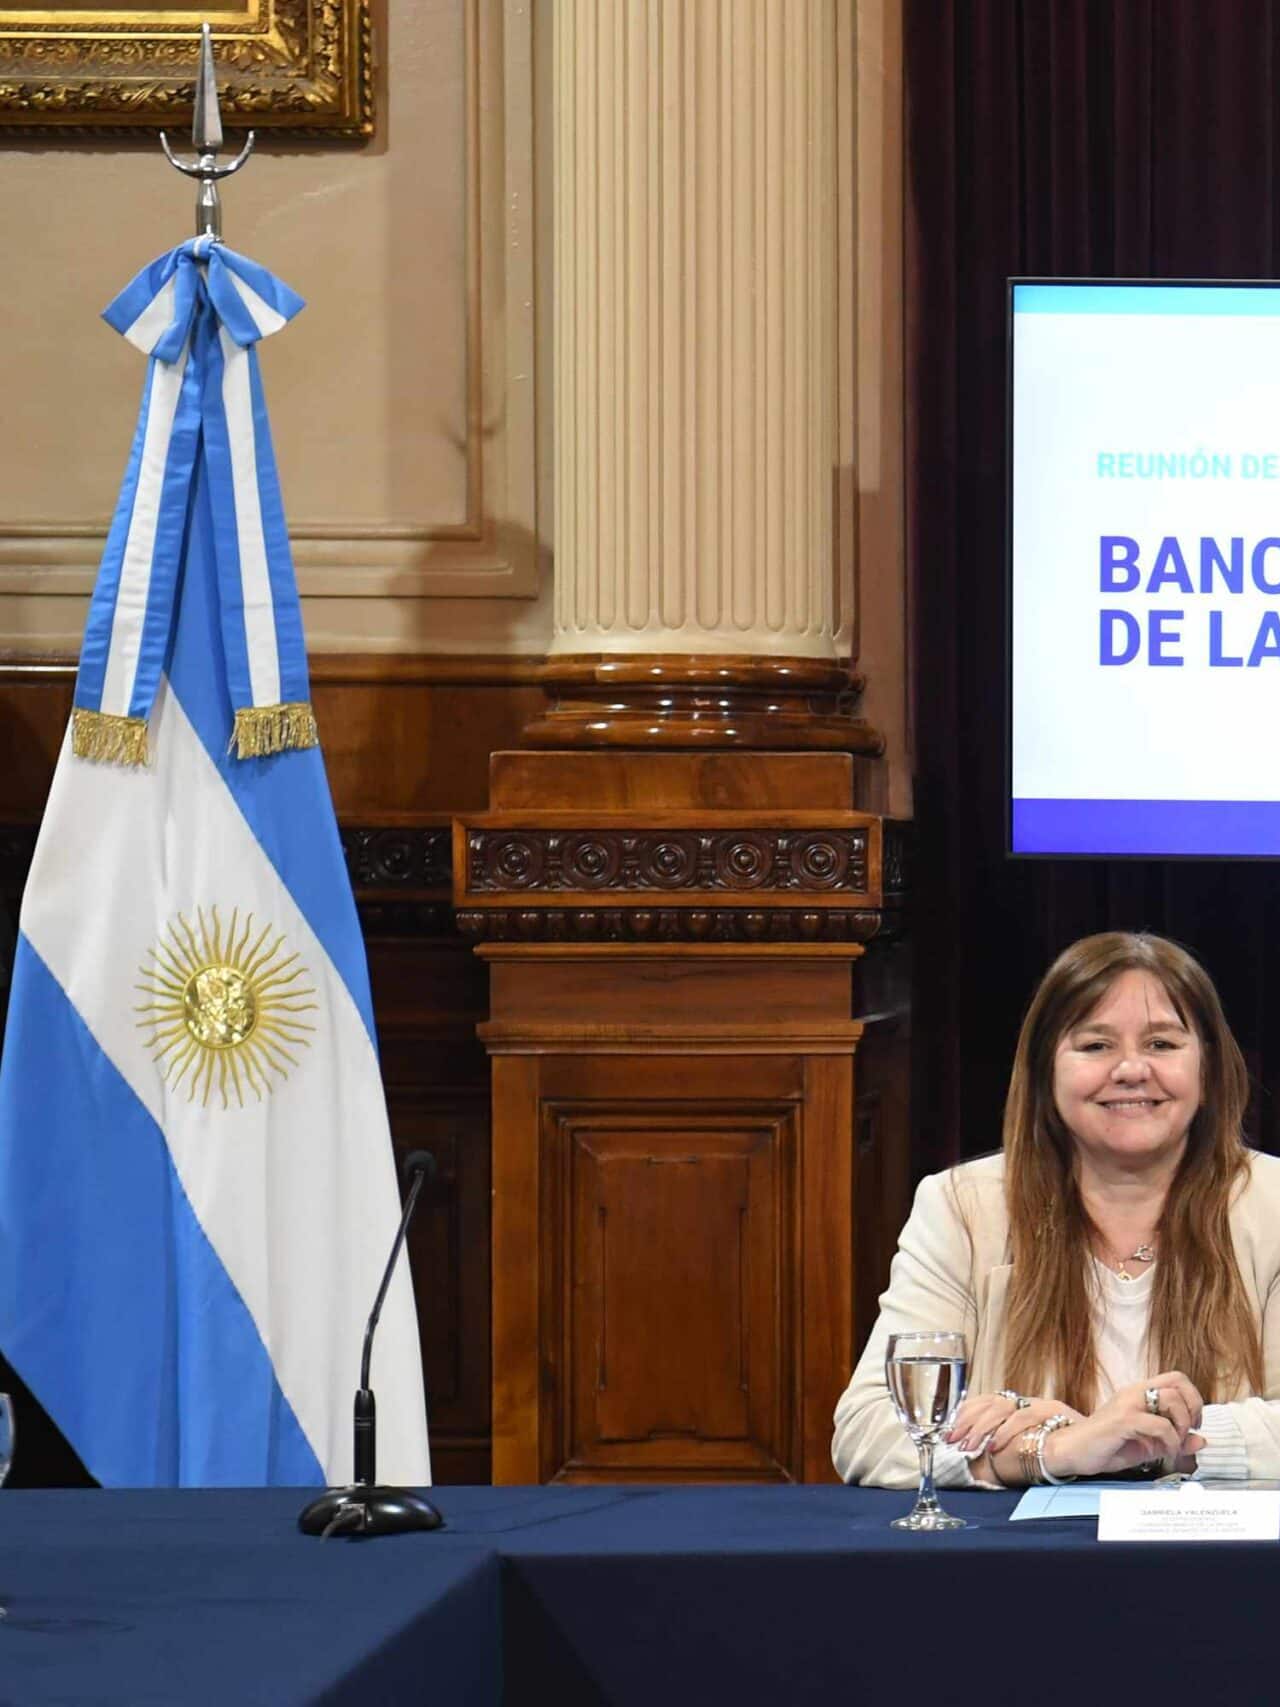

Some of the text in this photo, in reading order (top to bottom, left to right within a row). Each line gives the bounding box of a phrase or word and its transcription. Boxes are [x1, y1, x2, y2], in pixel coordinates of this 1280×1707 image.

[1096, 446, 1232, 480] REUNIÓN
[1241, 454, 1279, 480] DE
[1099, 608, 1185, 667] DE
